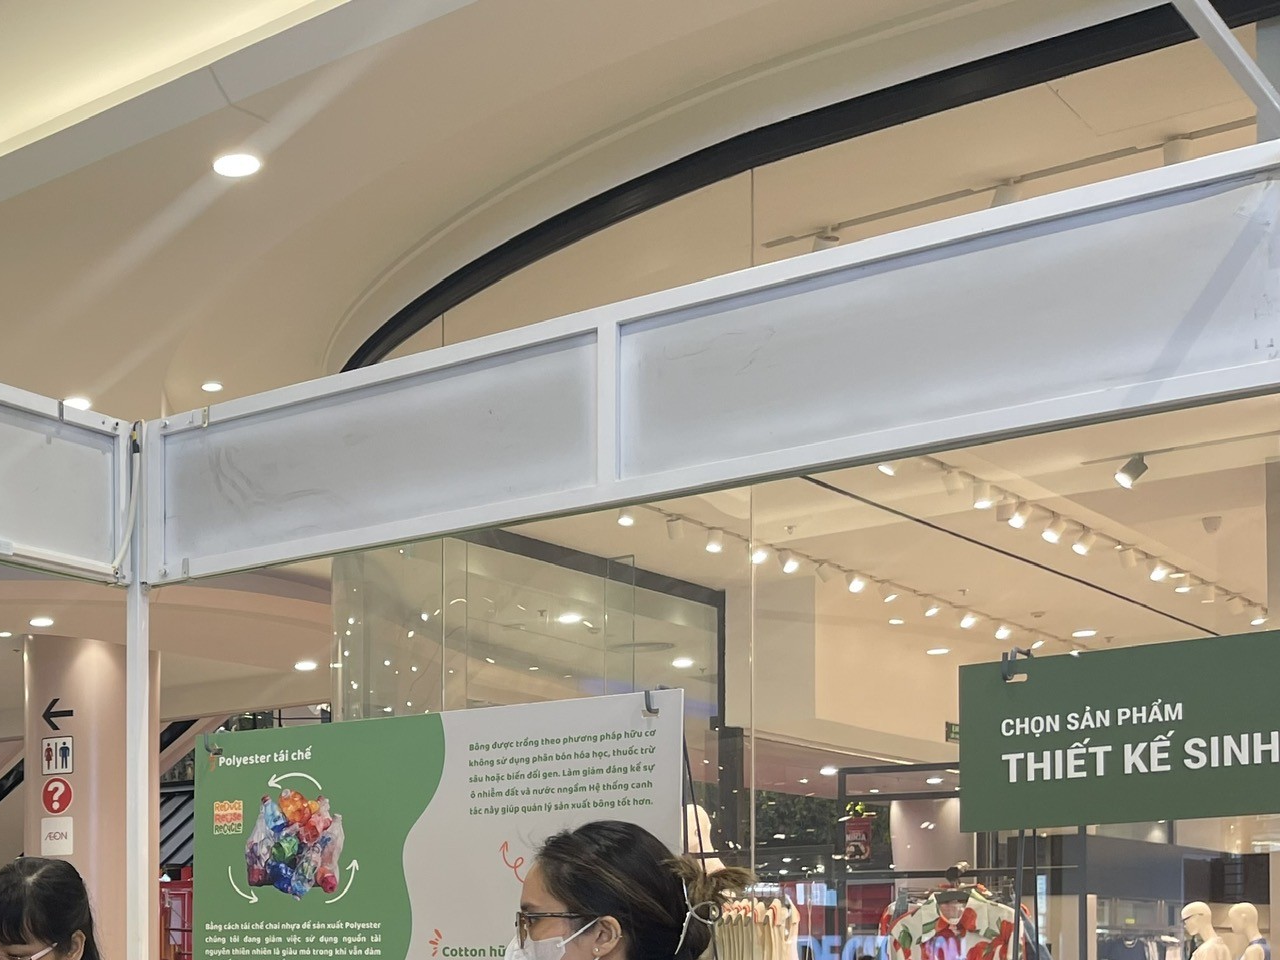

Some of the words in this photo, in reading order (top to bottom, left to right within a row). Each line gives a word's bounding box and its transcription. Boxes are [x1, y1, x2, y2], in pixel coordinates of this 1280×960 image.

[1001, 714, 1060, 737] CHỌN
[1067, 706, 1110, 731] SẢN
[1118, 699, 1183, 726] PHẨM
[469, 743, 490, 751] Bông
[492, 741, 513, 750] được
[563, 734, 597, 745] phương
[600, 732, 622, 742] pháp
[624, 730, 642, 738] hữu
[219, 754, 270, 767] Polyester
[274, 750, 288, 762] tái
[291, 745, 312, 760] chế
[469, 758, 494, 767] không
[497, 756, 507, 765] sử
[509, 755, 530, 764] dụng
[532, 753, 553, 764] phân
[556, 751, 572, 760] bón
[574, 750, 590, 759] hóa
[592, 748, 610, 758] học,
[613, 746, 638, 756] thuốc
[1001, 738, 1112, 782] THIẾT
[1124, 730, 1175, 774] KẾ
[1183, 731, 1280, 769] SINH
[469, 775, 483, 783] sâu
[507, 771, 525, 781] biến
[543, 771, 560, 779] gen.
[563, 769, 580, 777] Làm
[582, 767, 604, 777] giảm
[606, 764, 628, 774] đáng
[643, 764, 655, 773] sự
[471, 790, 475, 798] ô
[505, 785, 518, 796] đất
[521, 786, 530, 795] và
[532, 785, 555, 794] nước
[589, 782, 600, 793] Hệ
[603, 779, 628, 791] thống
[631, 780, 652, 788] canh
[470, 806, 482, 815] tác
[484, 805, 499, 815] này
[501, 804, 519, 815] giúp
[522, 803, 542, 813] quản
[544, 801, 552, 812] lý
[554, 802, 569, 810] sản
[572, 798, 590, 809] xuất
[593, 798, 615, 808] bông
[617, 795, 630, 806] tốt
[633, 797, 653, 806] hơn.
[206, 921, 222, 932] Bằng
[252, 921, 264, 929] chế
[282, 922, 300, 931] nhựa
[302, 920, 311, 929] để
[327, 920, 343, 929] xuất
[345, 922, 381, 930] Polyester
[205, 936, 226, 944] chúng
[243, 935, 260, 944] đang
[265, 936, 282, 944] giảm
[287, 935, 301, 944] việc
[320, 935, 338, 944] dụng
[371, 934, 381, 942] tài
[205, 948, 230, 956] nguyên
[313, 948, 332, 956] trong
[349, 945, 362, 955] vẫn
[364, 947, 381, 955] đảm
[442, 946, 485, 957] Cotton
[490, 945, 506, 957] hữ
